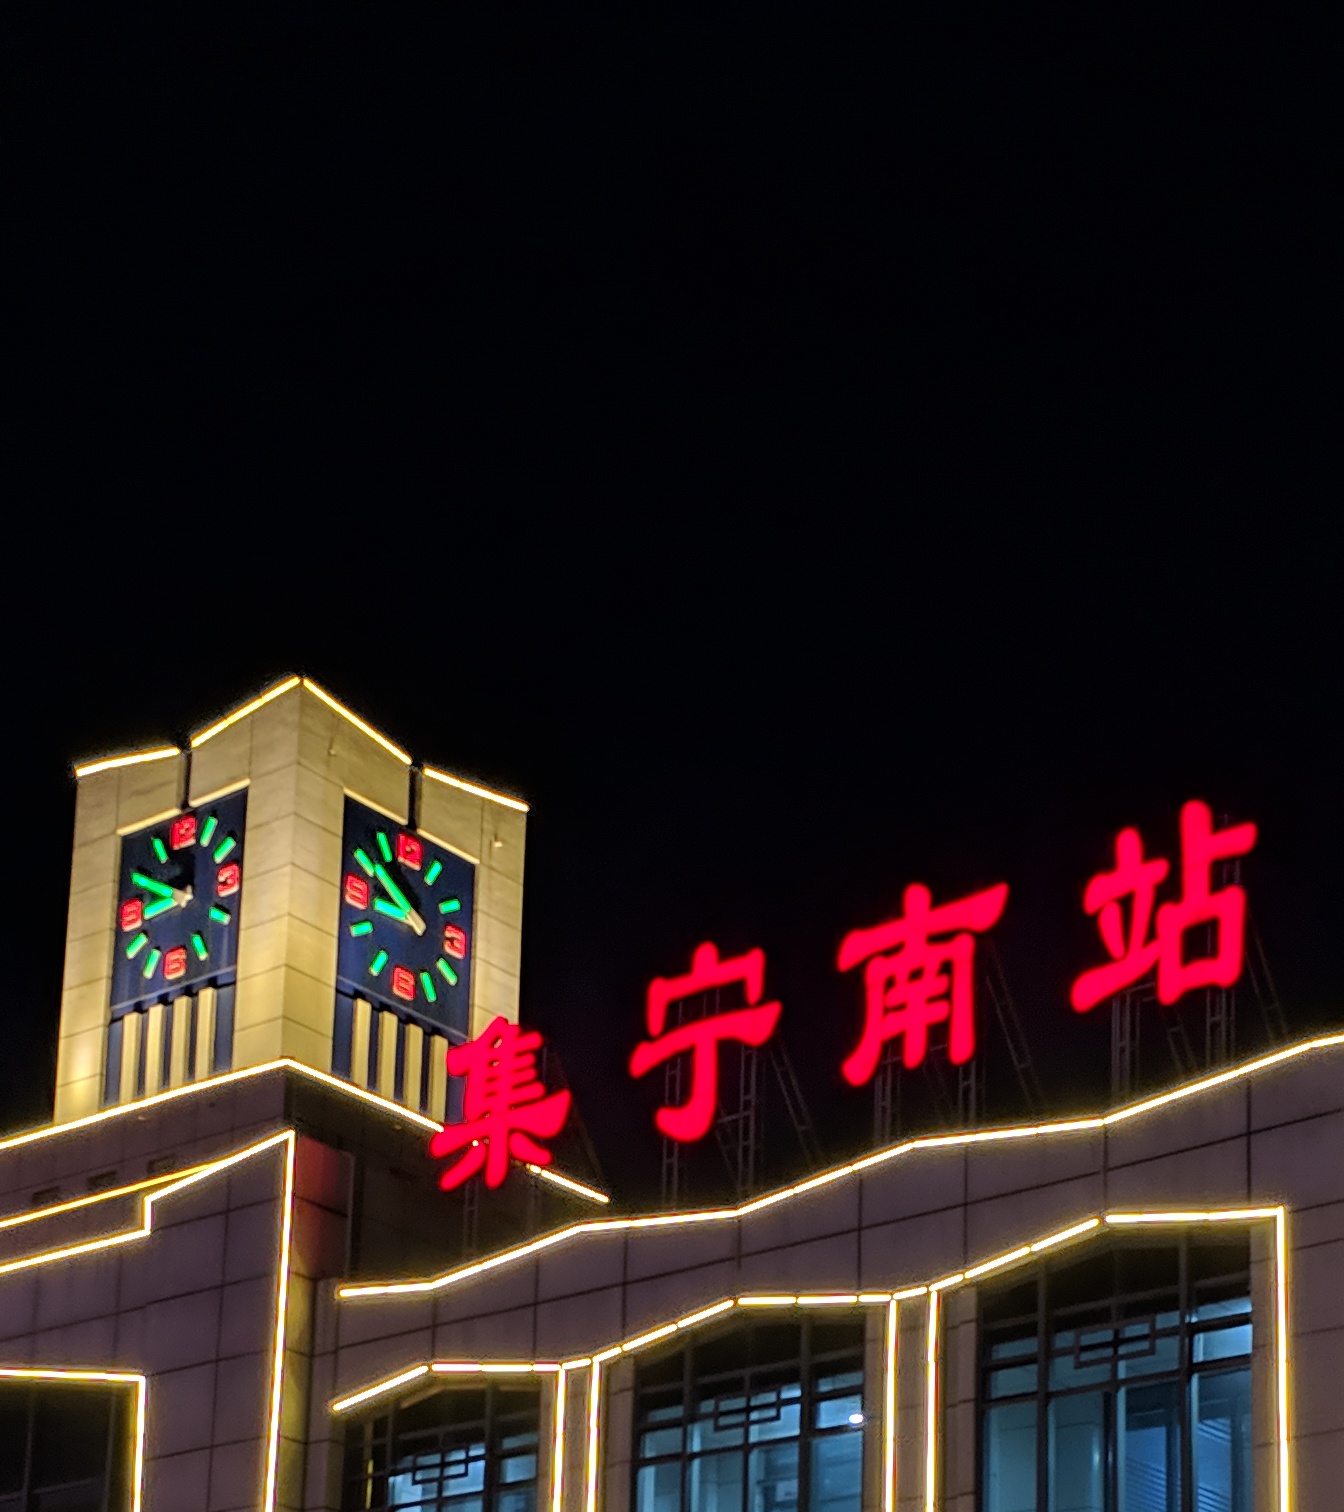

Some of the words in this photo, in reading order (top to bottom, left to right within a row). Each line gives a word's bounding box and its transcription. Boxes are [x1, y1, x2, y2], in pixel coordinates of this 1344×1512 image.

[216, 862, 240, 898] 3
[344, 872, 369, 910] 9
[120, 898, 143, 932] 9
[443, 922, 467, 960] 3
[163, 945, 187, 980] 6
[391, 964, 416, 1001] 6
[430, 801, 1256, 1189] 集宁南站
